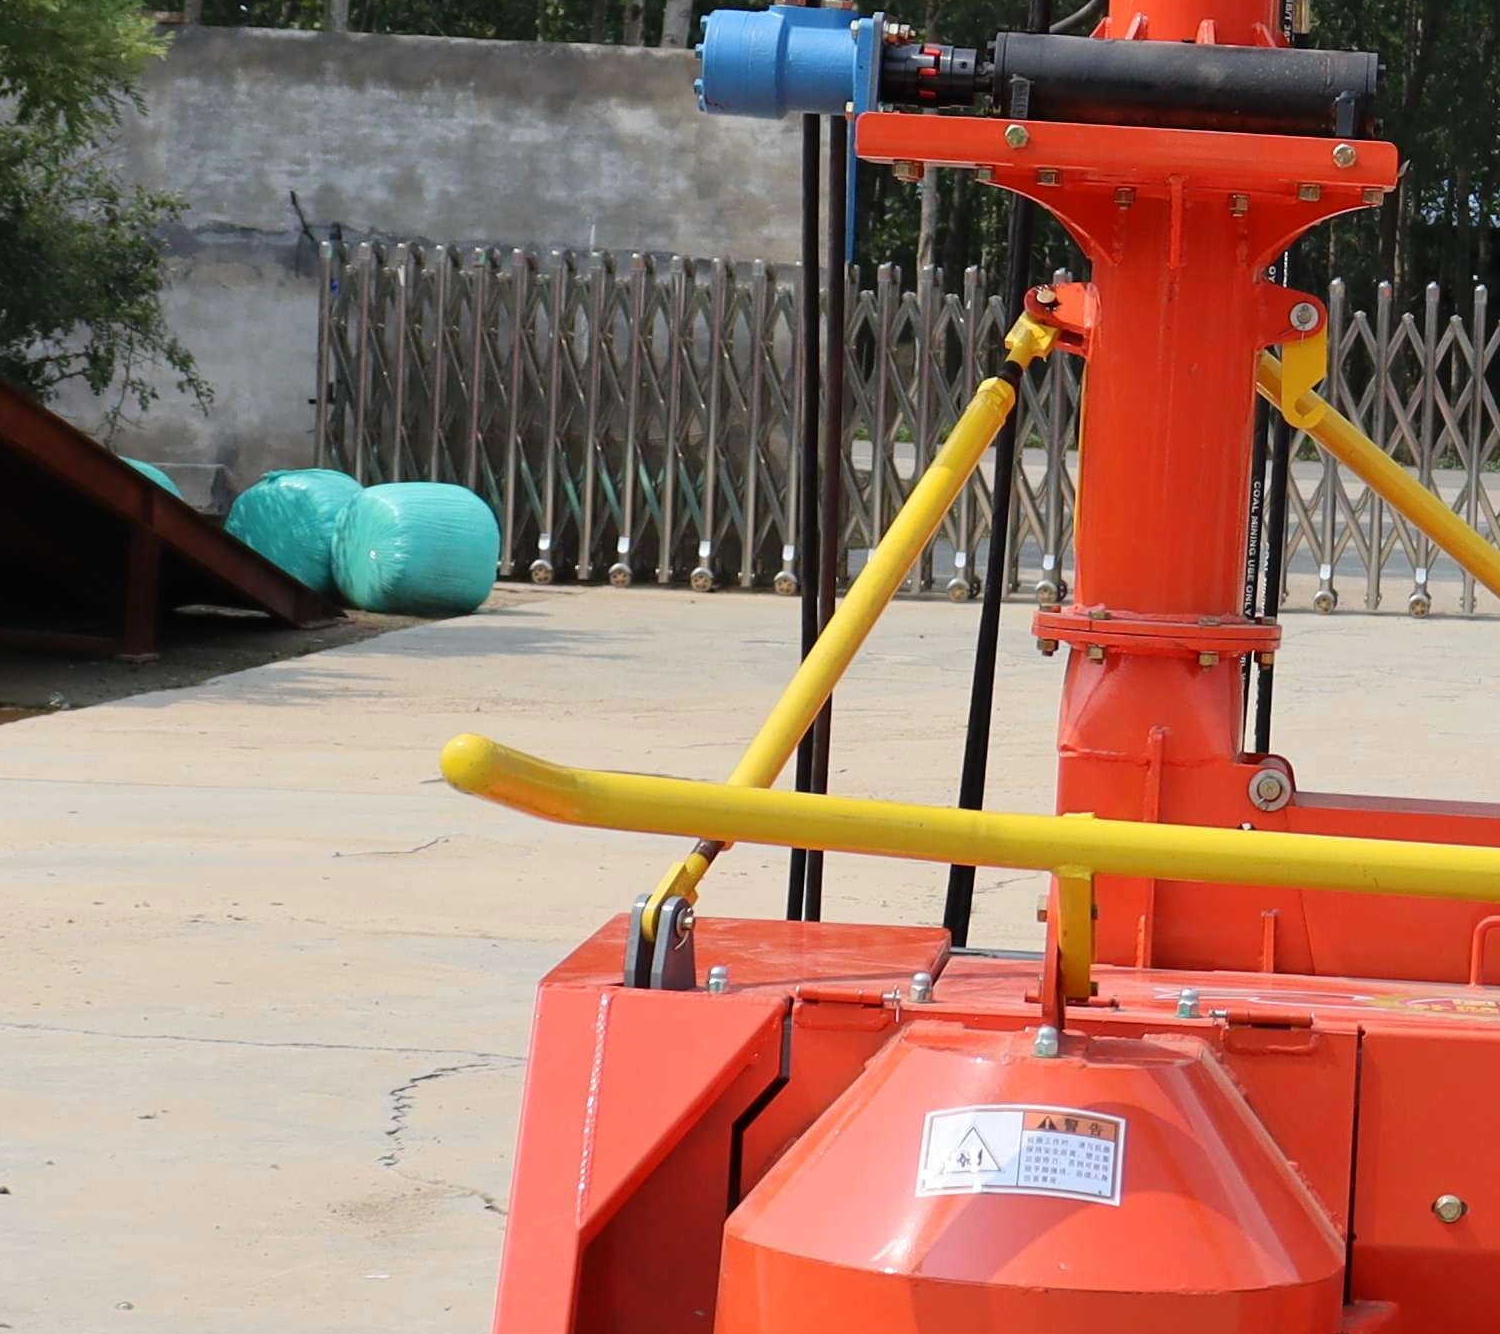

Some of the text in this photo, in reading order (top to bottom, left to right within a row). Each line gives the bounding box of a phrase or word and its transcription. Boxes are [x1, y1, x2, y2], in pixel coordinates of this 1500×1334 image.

[1244, 480, 1261, 616] COAL MINING USE ONLY
[1064, 1118, 1103, 1138] 警告
